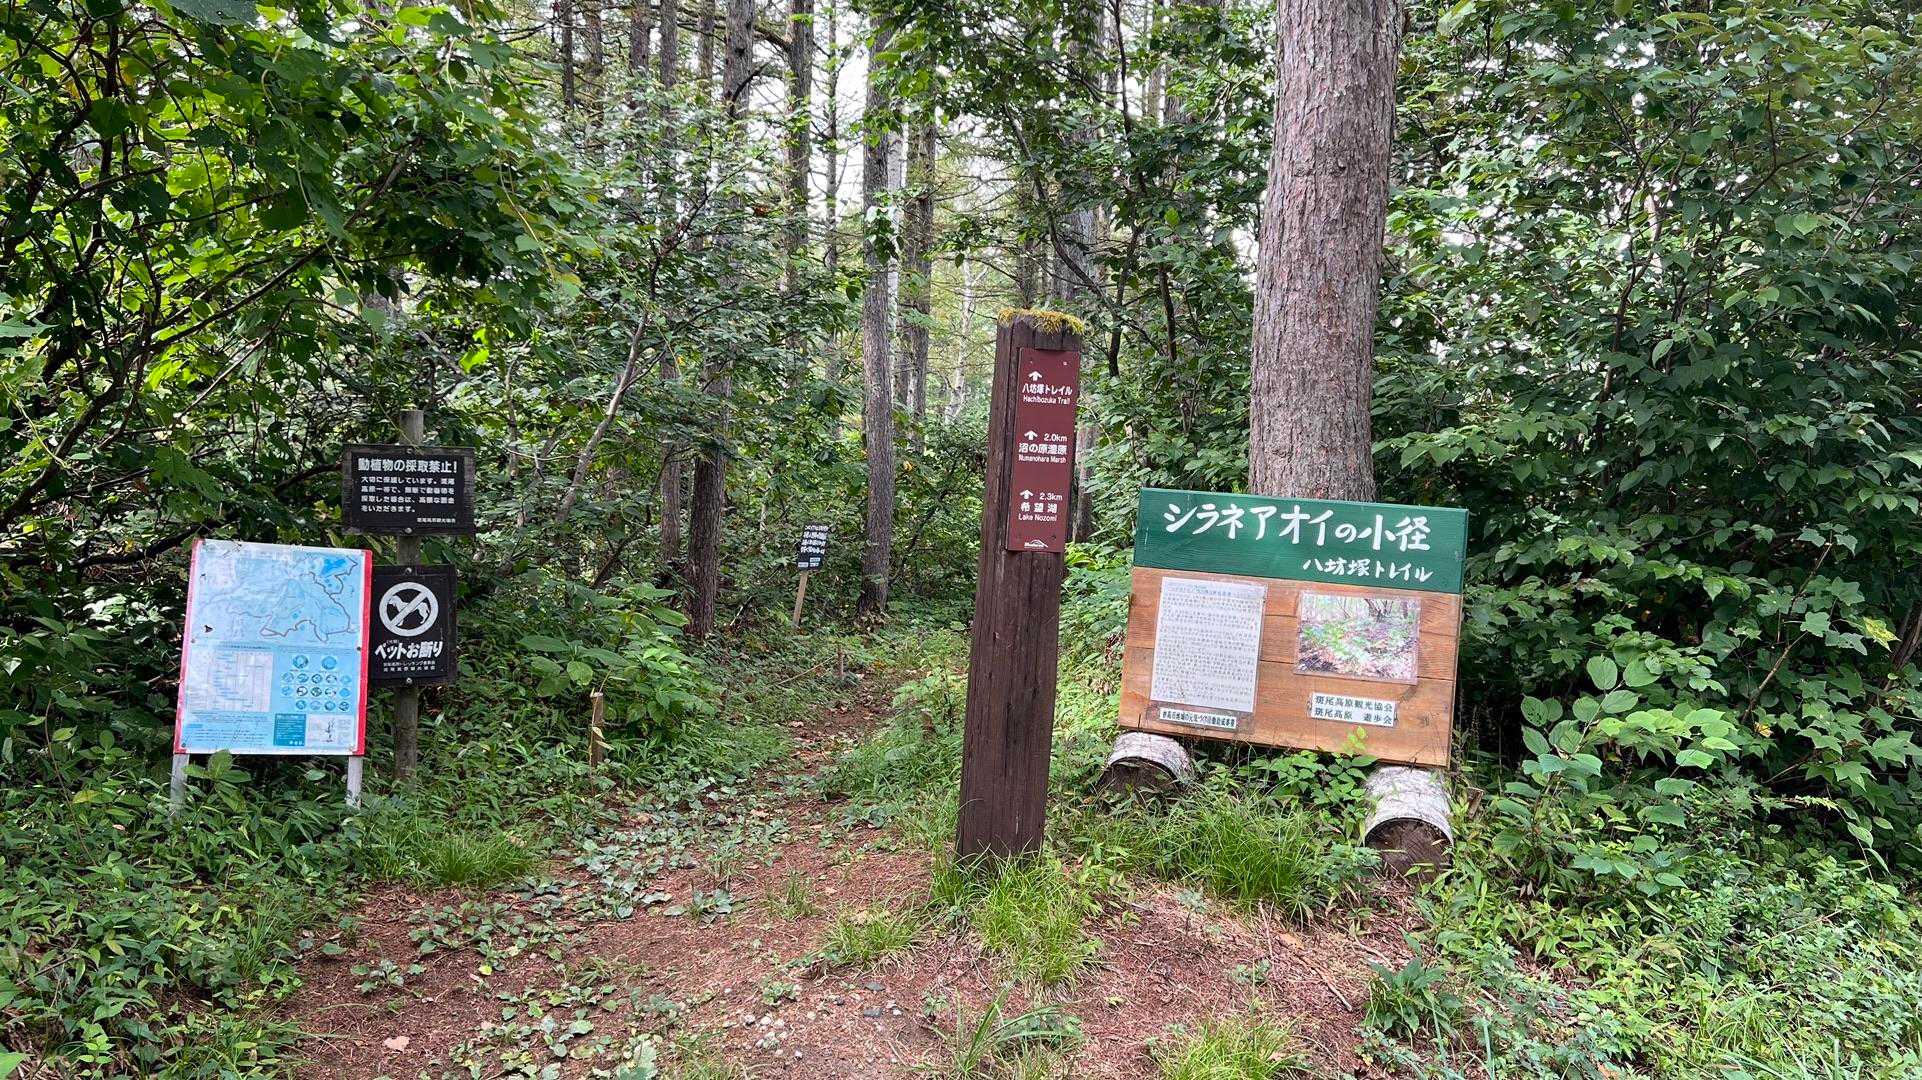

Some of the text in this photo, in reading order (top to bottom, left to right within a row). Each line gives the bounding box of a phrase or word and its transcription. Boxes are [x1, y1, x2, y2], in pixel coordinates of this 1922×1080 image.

[1022, 383, 1073, 395] 八坊塚トレイル
[1023, 395, 1071, 405] Hachibozuka Trail
[1044, 433, 1068, 442] 2.0km
[1018, 442, 1068, 455] 沼の原湿原
[1018, 454, 1067, 463] Numanohara Marsh
[1039, 492, 1063, 501] 2.3km
[1018, 513, 1058, 522] Lake Nozomi
[1163, 503, 1432, 552] シラネアオイの小径
[1302, 556, 1434, 582] 八坊塚トレイル
[374, 641, 443, 659] ペットお断り
[1315, 695, 1393, 712] 斑尾高原観光協会
[1314, 707, 1353, 720] 斑尾高原
